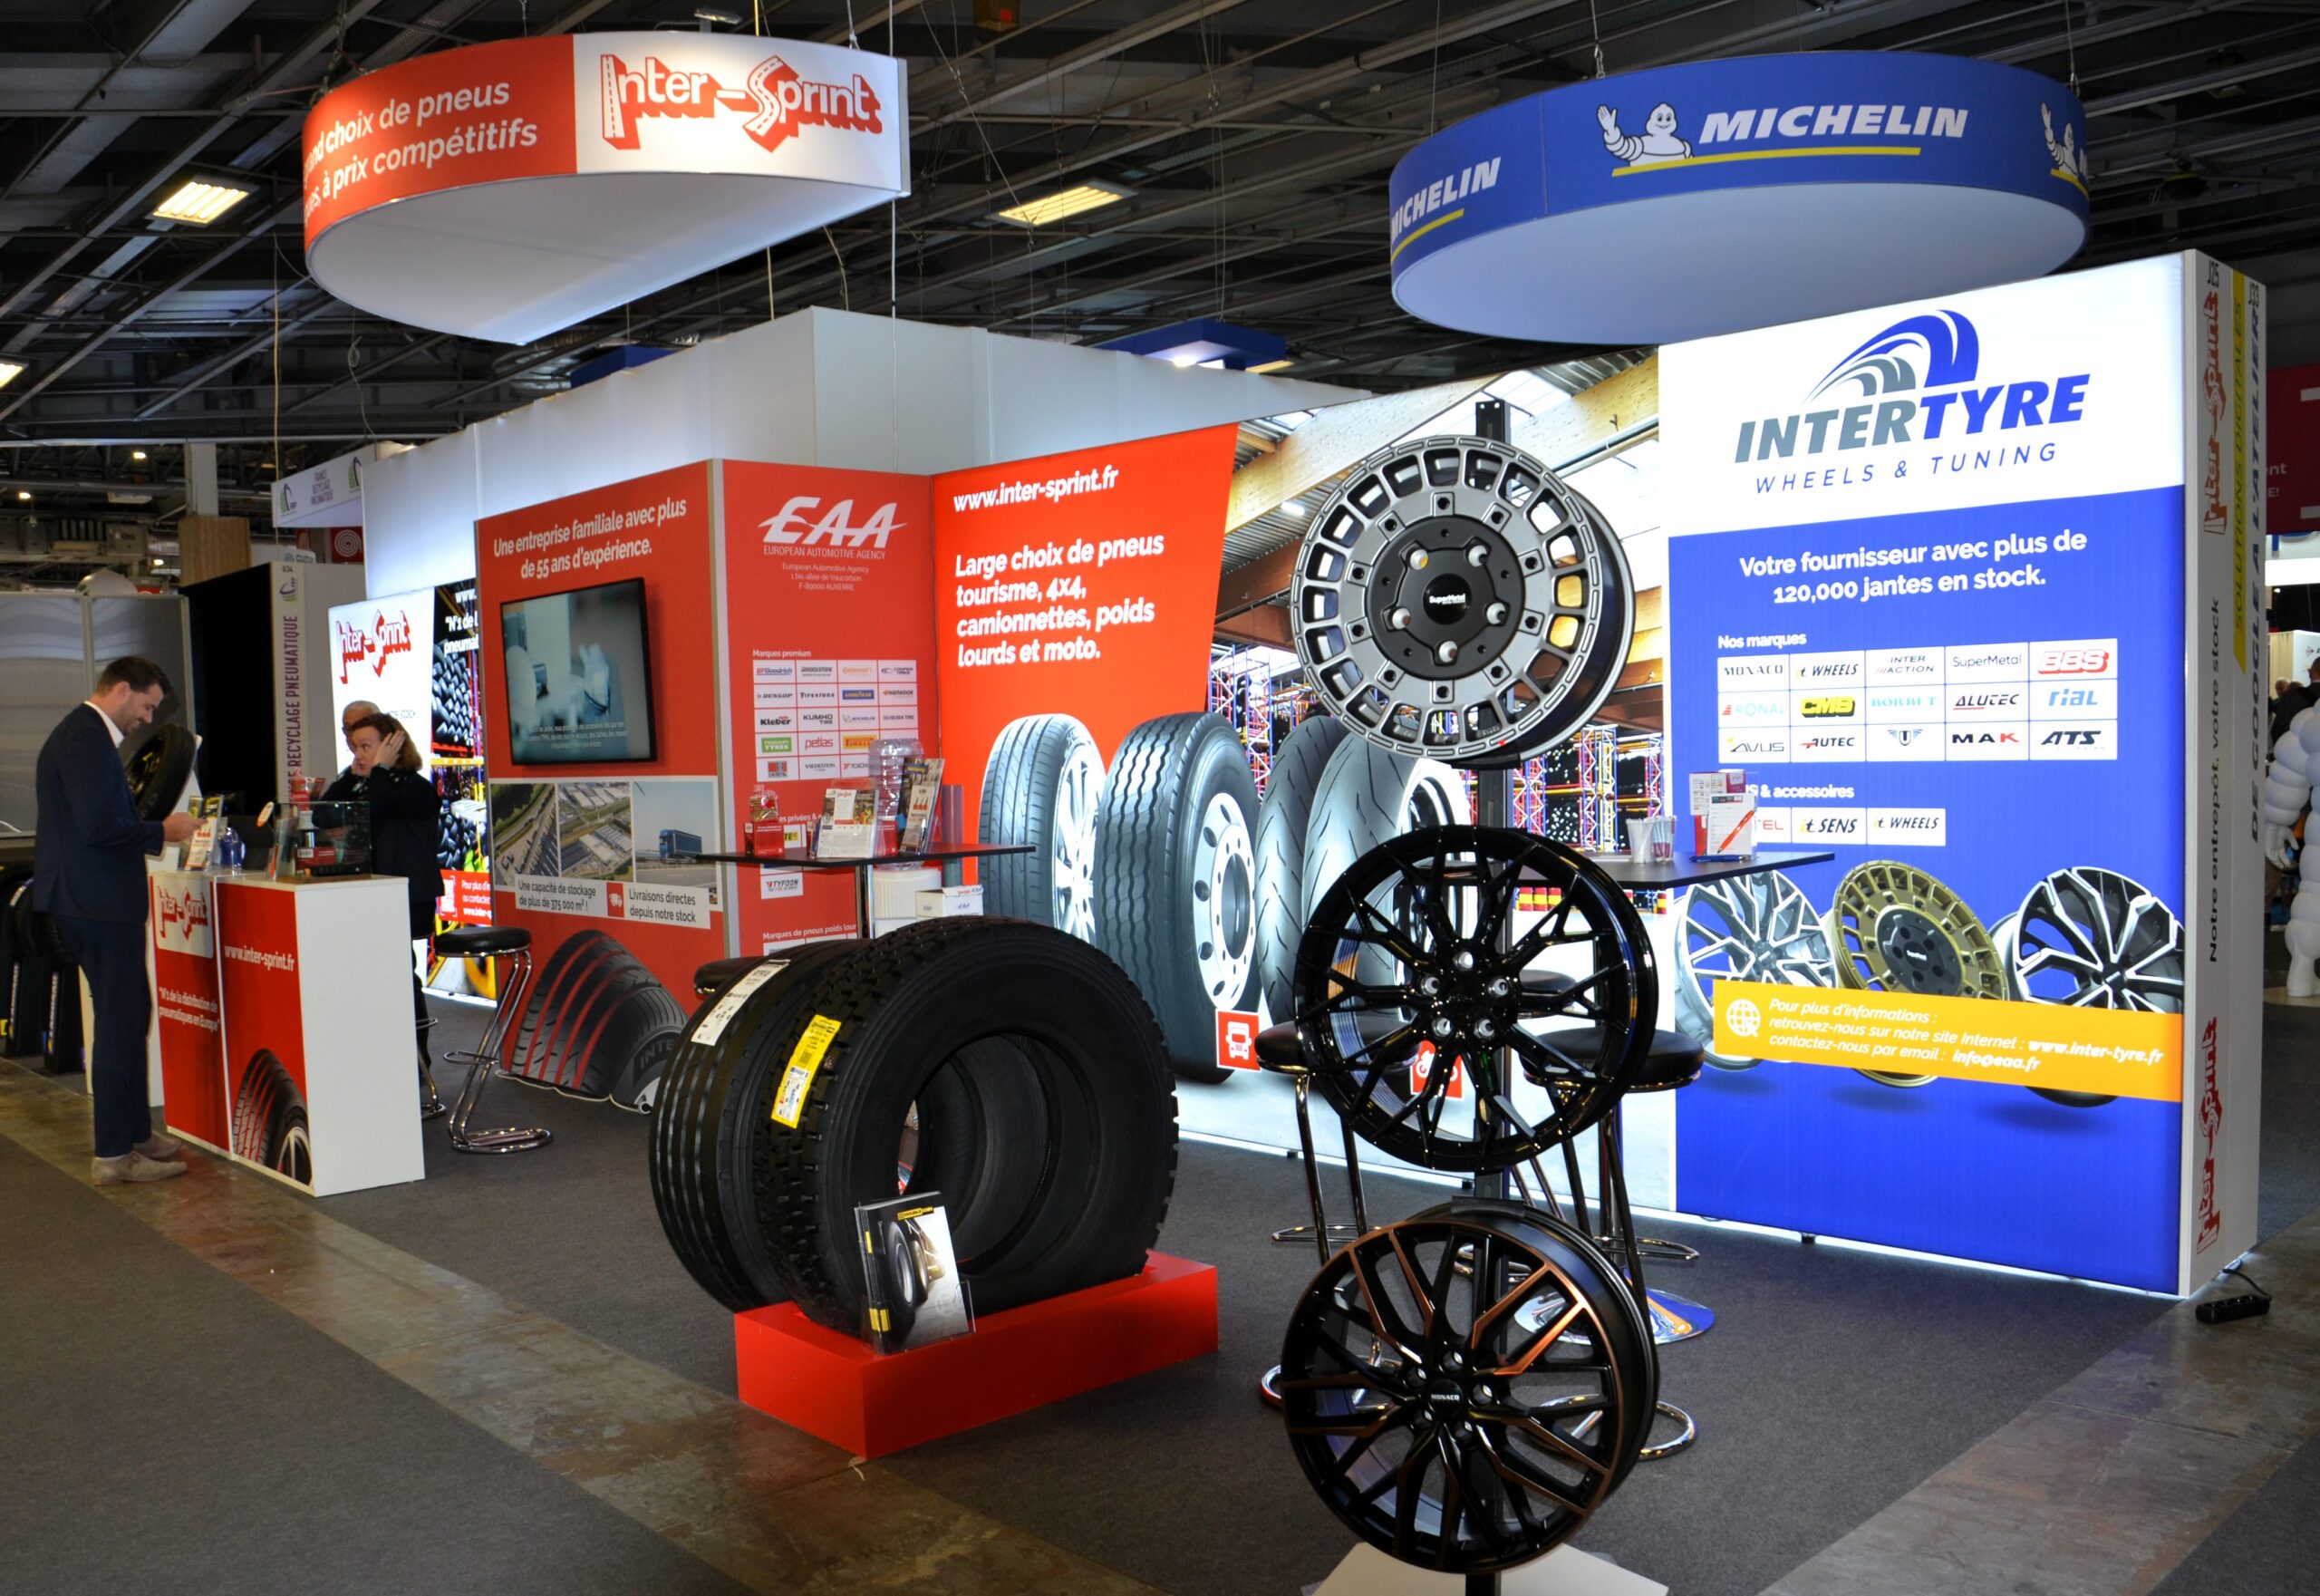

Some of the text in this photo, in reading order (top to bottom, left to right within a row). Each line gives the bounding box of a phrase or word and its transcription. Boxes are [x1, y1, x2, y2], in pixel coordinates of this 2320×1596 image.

[326, 82, 510, 154] choix de pneus
[601, 53, 883, 153] Inter-Sprint
[1698, 103, 1968, 144] MICHELIN
[333, 154, 369, 199] prix
[373, 117, 538, 175] compétitifs
[1756, 442, 2056, 494] WHEELS & TUNING
[953, 465, 1120, 513] www.inter-sprint.fr
[493, 498, 687, 558] Une entreprise familiale avec plus
[758, 496, 908, 549] EAA
[521, 538, 652, 580] de 55 ans d'expérience.
[763, 545, 885, 560] EUROPEAN AUTOMOTIVE AGENCY
[782, 563, 812, 572] European
[955, 533, 1165, 580] Large choix de pneus
[1739, 528, 2087, 577] Votre fournisseur avec plus de
[956, 575, 1087, 607] tourisme, 4x4,
[1429, 594, 1465, 605] SuperMetal
[1774, 564, 2046, 605] 120,000 jantes en stock.
[957, 596, 1155, 638] camionnettes, poids
[1717, 631, 1807, 649] Nos marques
[2211, 598, 2220, 673] stock
[283, 615, 299, 698] PNEUMATIQUE
[753, 649, 812, 659] Marques premium
[957, 637, 1101, 669] lourds et moto.
[1890, 655, 1926, 663] INTER
[1952, 653, 2022, 669] SuperMetal
[2038, 649, 2110, 674] BBS
[1812, 663, 1859, 677] WHEELS
[2251, 582, 2259, 770] GOOGLE
[2211, 680, 2219, 749] votre
[285, 701, 302, 768] RECYCLAGE
[1952, 732, 2020, 743] MAK
[2041, 730, 2102, 746] ATS
[1759, 784, 1771, 798] &
[1773, 784, 1855, 799] accessoires
[788, 814, 811, 824] privées
[1818, 817, 1858, 834] SENS
[1890, 817, 1939, 829] WHEELS
[518, 881, 596, 899] Une capacité de stockage
[519, 896, 527, 905] de
[527, 896, 541, 908] plus
[542, 898, 550, 908] de
[551, 900, 561, 912] 375
[629, 888, 696, 905] Livraisons directes
[630, 905, 696, 923] depuis notre stock
[2209, 888, 2218, 963] Notre
[763, 931, 793, 942] Marques
[803, 928, 824, 937] pneus
[825, 925, 843, 935] poids
[224, 945, 295, 972] www.inter-sprint.fr
[1769, 998, 1929, 1023] Pour plus d'informations
[1769, 1017, 1866, 1037] retrouvez-nous
[1868, 1027, 1891, 1038] sur
[1893, 1027, 1930, 1041] notre
[1931, 1030, 1958, 1045] site
[1960, 1032, 2019, 1049] Internet
[2028, 1040, 2165, 1066] www.inter-tyre.fr
[1769, 1034, 1870, 1054] contactez-nous
[1872, 1044, 1896, 1058] par
[1899, 1046, 1938, 1060] email
[1951, 1049, 2042, 1072] info@eaa.fr
